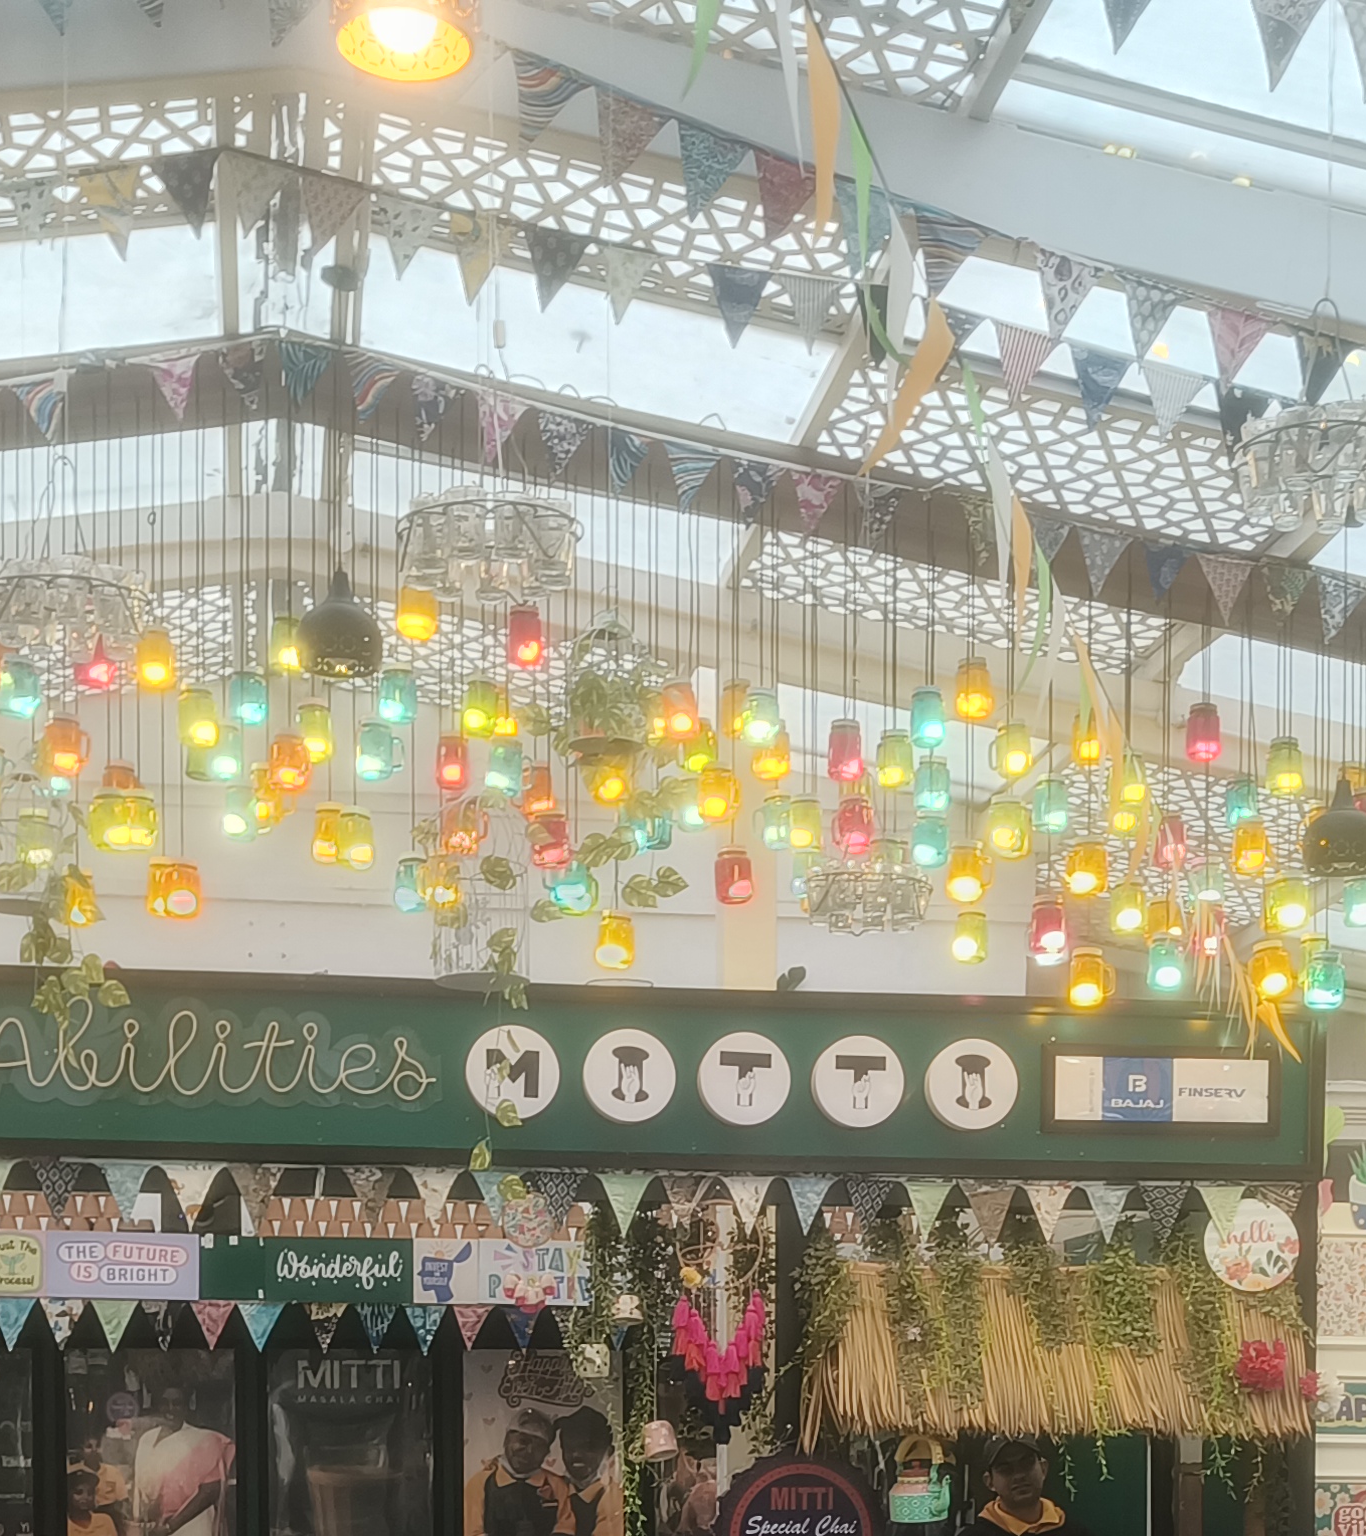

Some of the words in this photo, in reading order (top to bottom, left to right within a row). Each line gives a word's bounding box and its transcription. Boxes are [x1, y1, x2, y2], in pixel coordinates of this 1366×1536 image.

[1178, 1087, 1246, 1098] FINSERV
[1111, 1099, 1164, 1109] BAJAJ
[65, 1245, 100, 1260] THE
[112, 1245, 180, 1263] FUTURE
[521, 1247, 581, 1275] STAY
[77, 1265, 92, 1280] IS
[106, 1268, 170, 1283] BRIGHT
[277, 1250, 403, 1290] Wonderful
[297, 1359, 401, 1390] MITTI
[770, 1486, 834, 1511] MITTI
[745, 1515, 810, 1536] Special
[815, 1515, 857, 1536] Chai
